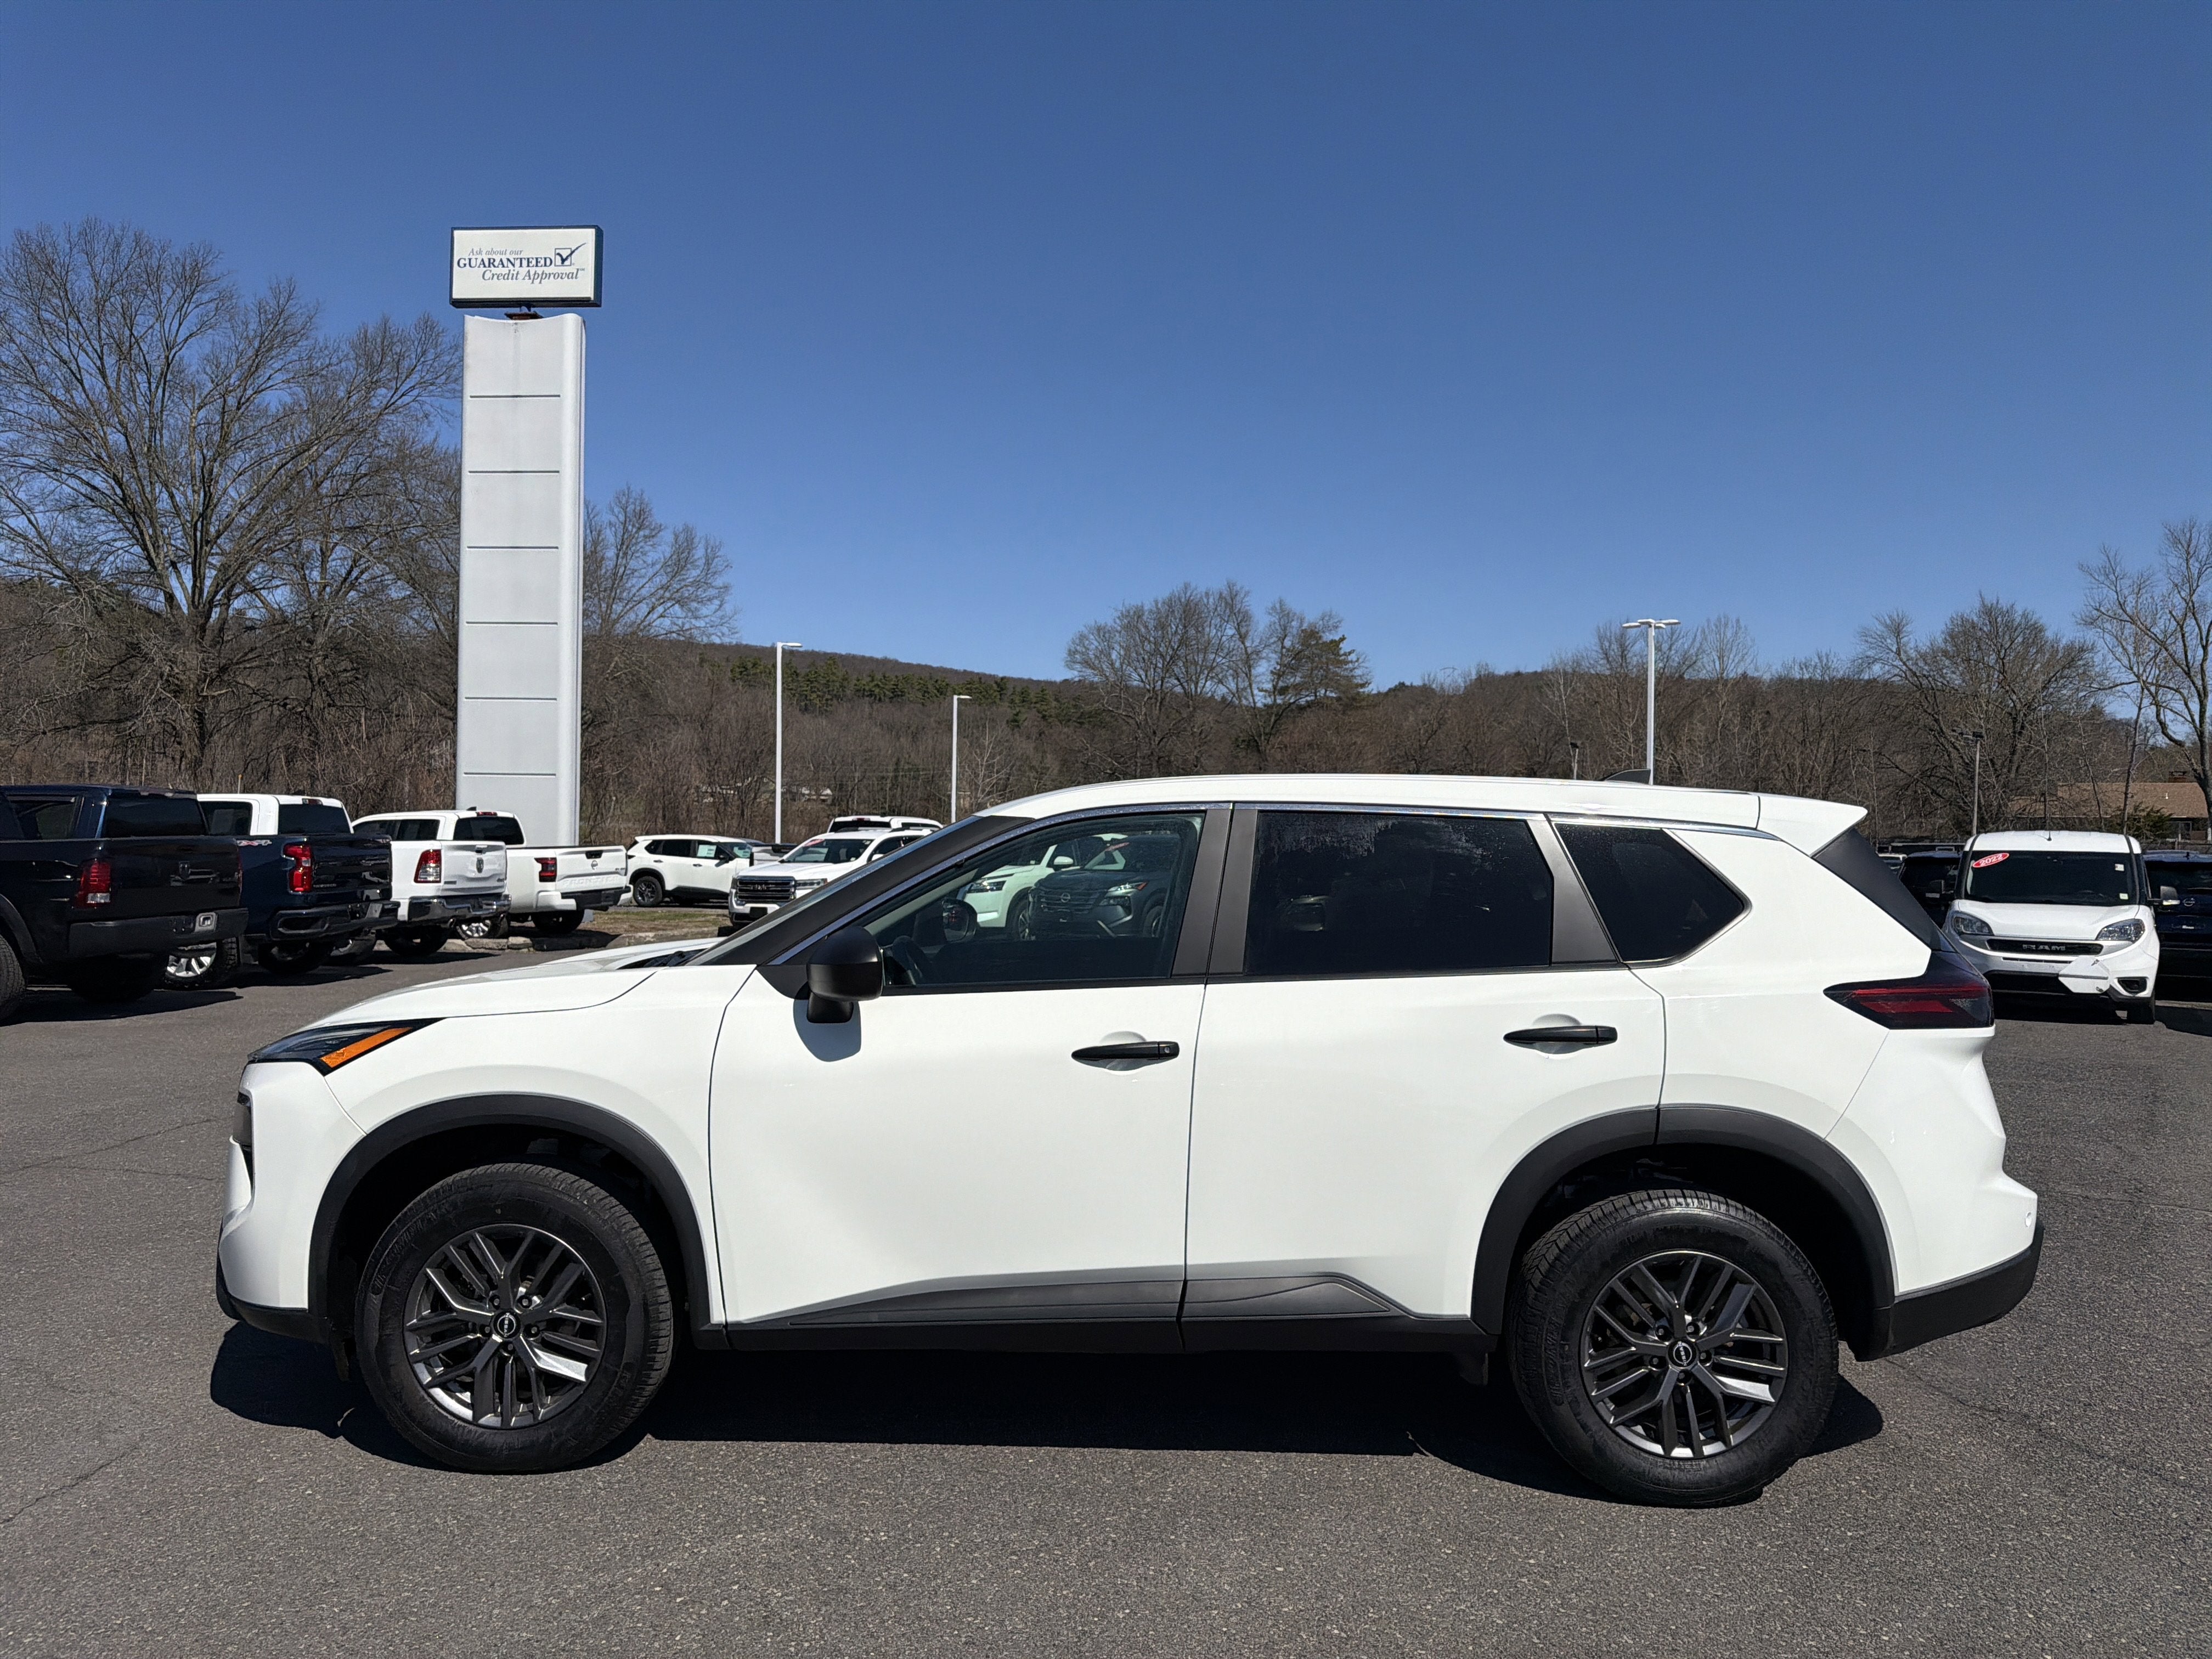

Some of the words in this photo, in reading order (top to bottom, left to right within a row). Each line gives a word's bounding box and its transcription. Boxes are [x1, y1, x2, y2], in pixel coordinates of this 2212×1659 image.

[468, 248, 483, 256] Ask
[457, 257, 553, 268] GUARANTEED
[482, 268, 520, 281] Credit
[522, 268, 579, 284] Approval
[1979, 854, 2003, 867] 2022
[1678, 1341, 1688, 1366] NISSAN
